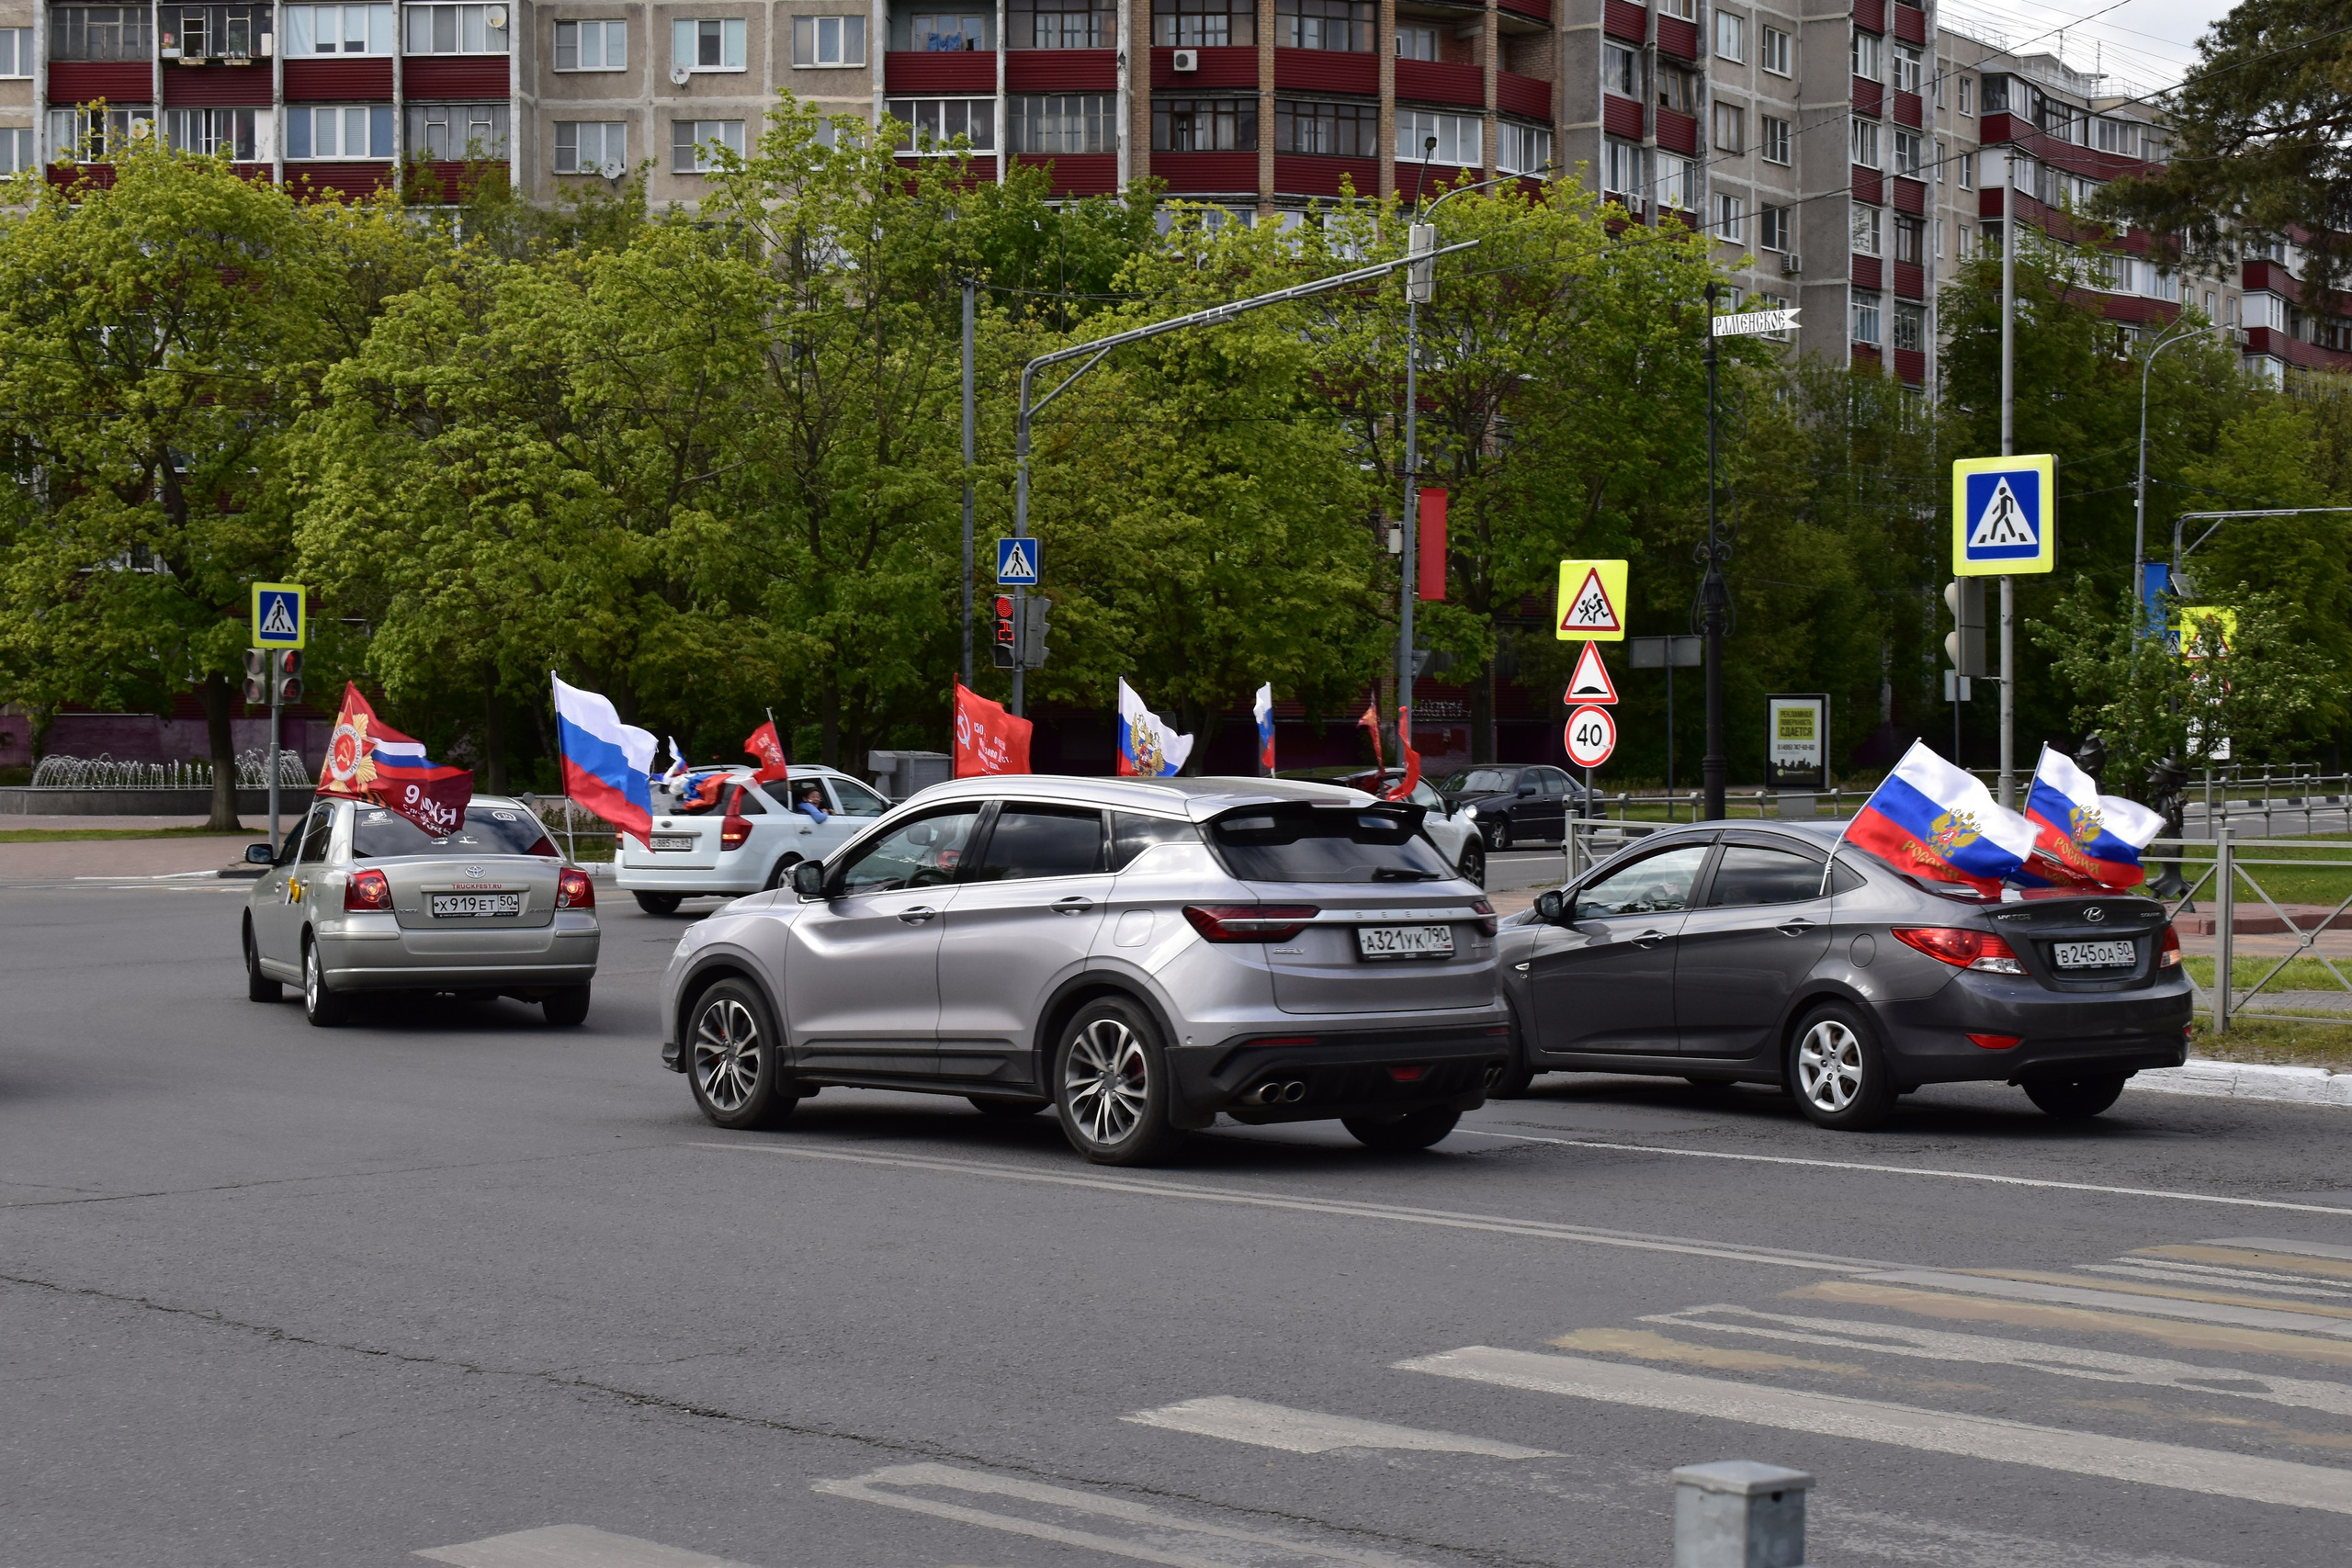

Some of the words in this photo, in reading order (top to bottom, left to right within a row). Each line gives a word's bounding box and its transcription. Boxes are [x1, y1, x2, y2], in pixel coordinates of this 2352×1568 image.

[1715, 310, 1785, 335] РАМЕНСКОЕ
[1577, 723, 1602, 746] 40
[1780, 727, 1813, 737] СДАЕТСЯ
[404, 784, 420, 804] 9
[1902, 840, 1960, 881] РОССИЯ
[2053, 837, 2100, 875] РОССИЯ
[499, 896, 514, 907] 50
[1355, 909, 1453, 919] GEELY
[1426, 927, 1448, 942] 790
[1272, 947, 1306, 955] GEELY
[2116, 942, 2130, 956] 50
